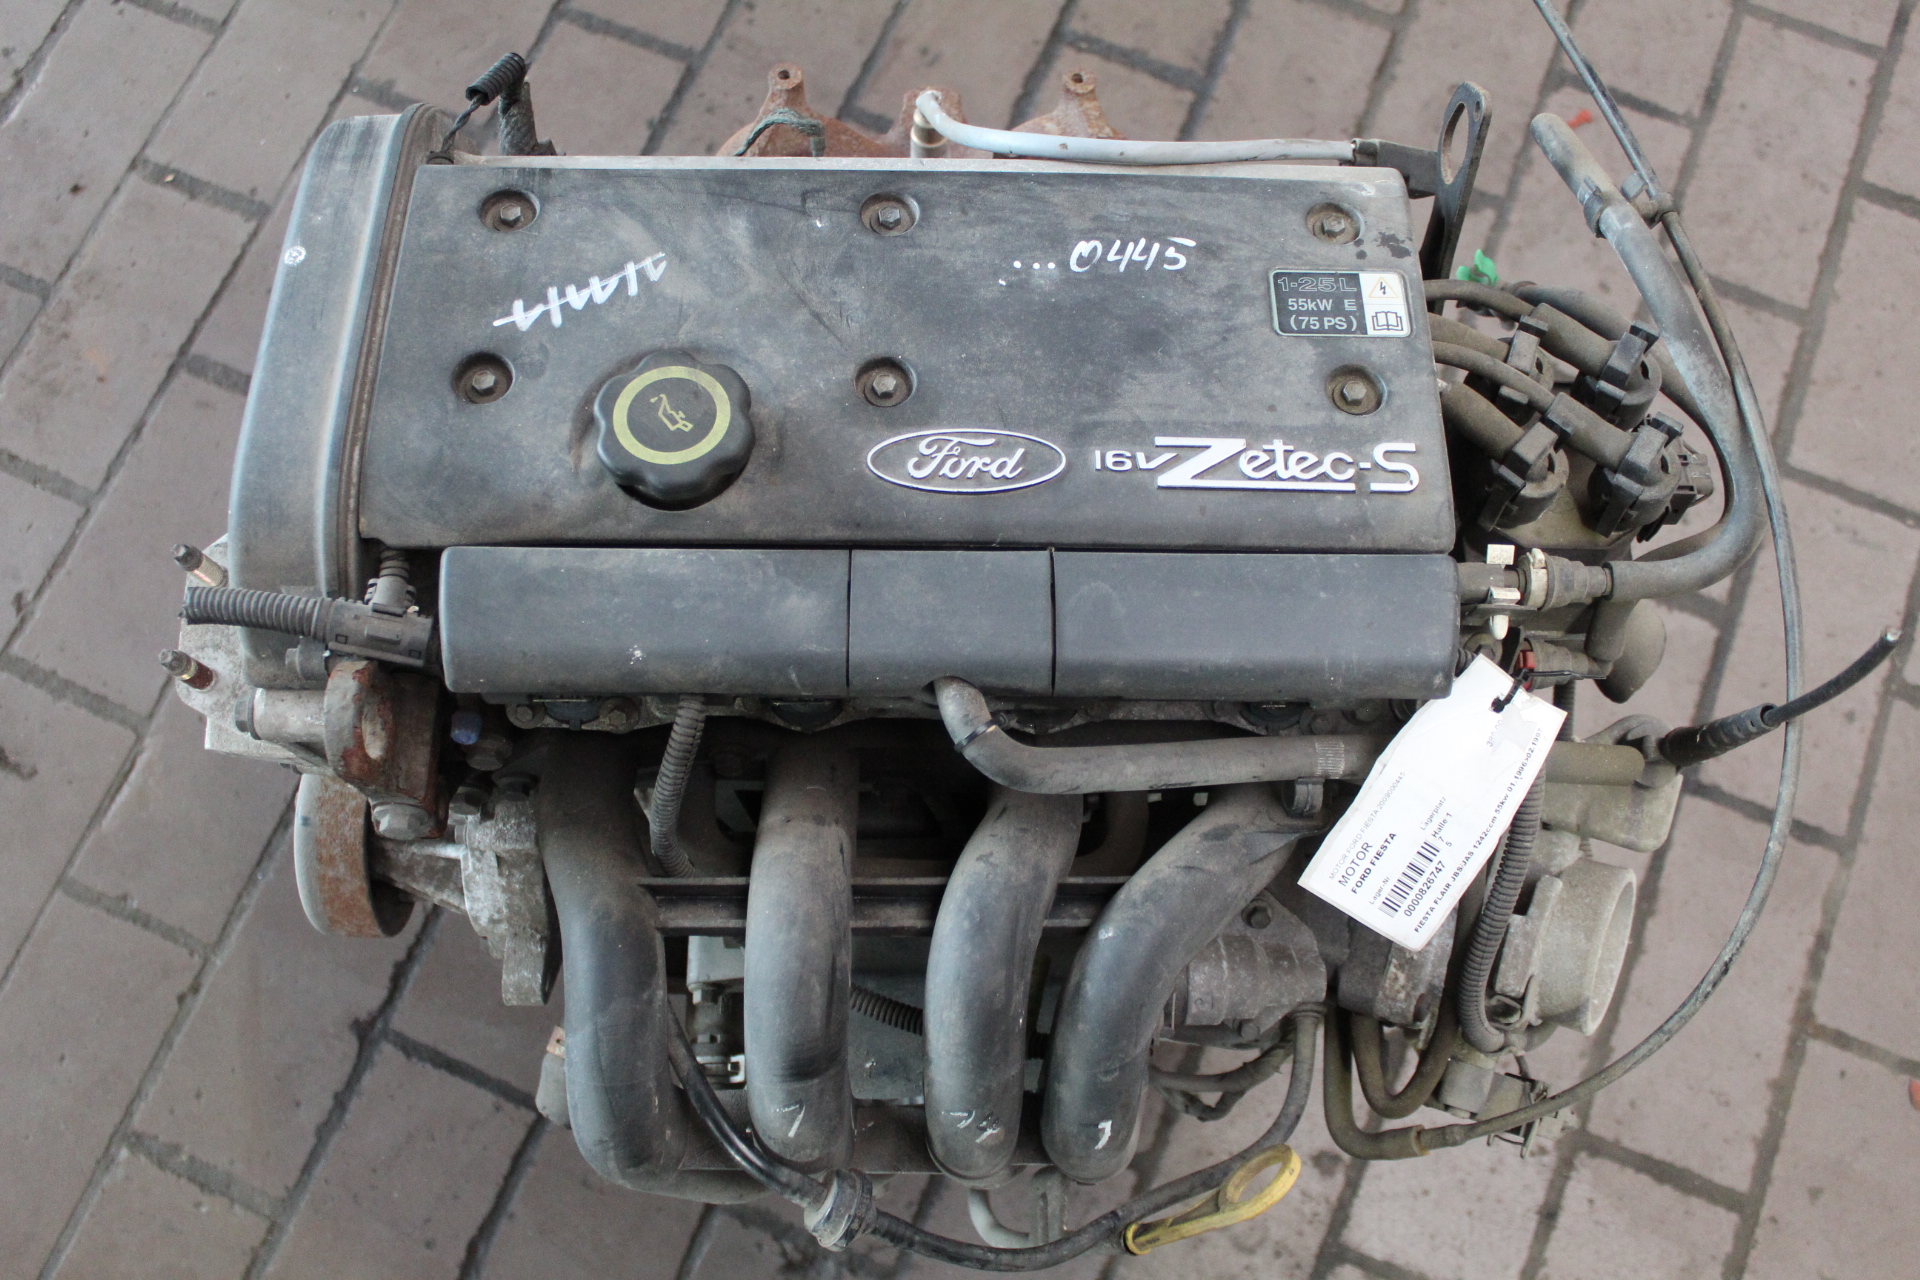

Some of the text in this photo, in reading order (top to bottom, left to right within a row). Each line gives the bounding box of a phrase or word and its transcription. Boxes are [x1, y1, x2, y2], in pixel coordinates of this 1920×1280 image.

[1288, 298, 1332, 311] 55kW
[907, 436, 1026, 479] Ford
[1154, 436, 1419, 492] Zetec-S
[1419, 794, 1447, 832] Lagerplatz
[1430, 811, 1453, 839] Halle 1
[1327, 852, 1349, 880] MOTOR
[1345, 832, 1363, 854] FORD
[1359, 807, 1380, 834] FIESTA
[1437, 835, 1446, 843] 7
[1444, 839, 1453, 848] 5
[1337, 840, 1373, 887] MOTOR
[1350, 830, 1397, 894] FORD FIESTA
[1413, 904, 1435, 933] FIESTA
[1432, 881, 1452, 905] FLAIR
[1471, 813, 1498, 850] 1242ccm
[1493, 792, 1510, 815] 55kw
[1402, 858, 1447, 918] 0000826747
